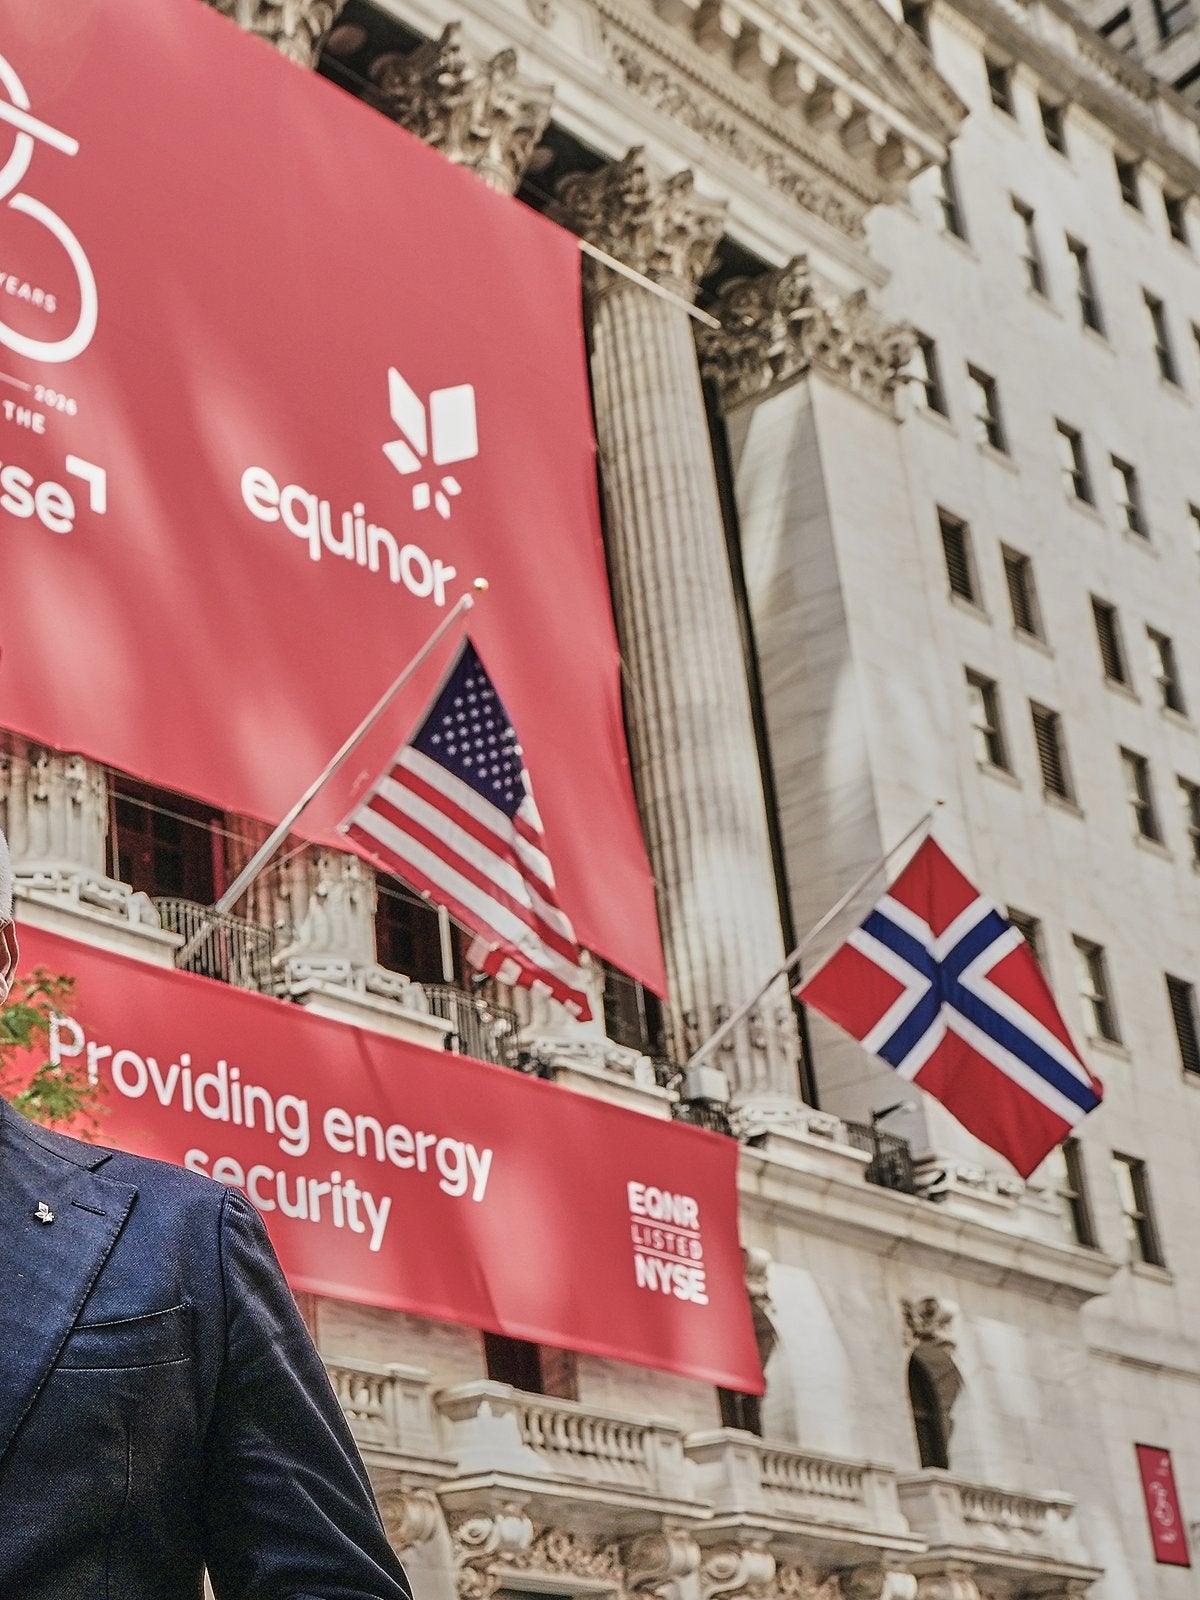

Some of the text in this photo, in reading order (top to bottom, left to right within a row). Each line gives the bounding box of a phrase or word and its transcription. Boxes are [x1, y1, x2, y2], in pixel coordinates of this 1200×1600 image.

[3, 400, 45, 434] THE
[241, 466, 457, 607] equinor
[49, 1012, 494, 1203] Providing energy
[627, 1180, 700, 1231] EQNR
[631, 1223, 703, 1260] LISTED
[634, 1253, 709, 1305] NYSE
